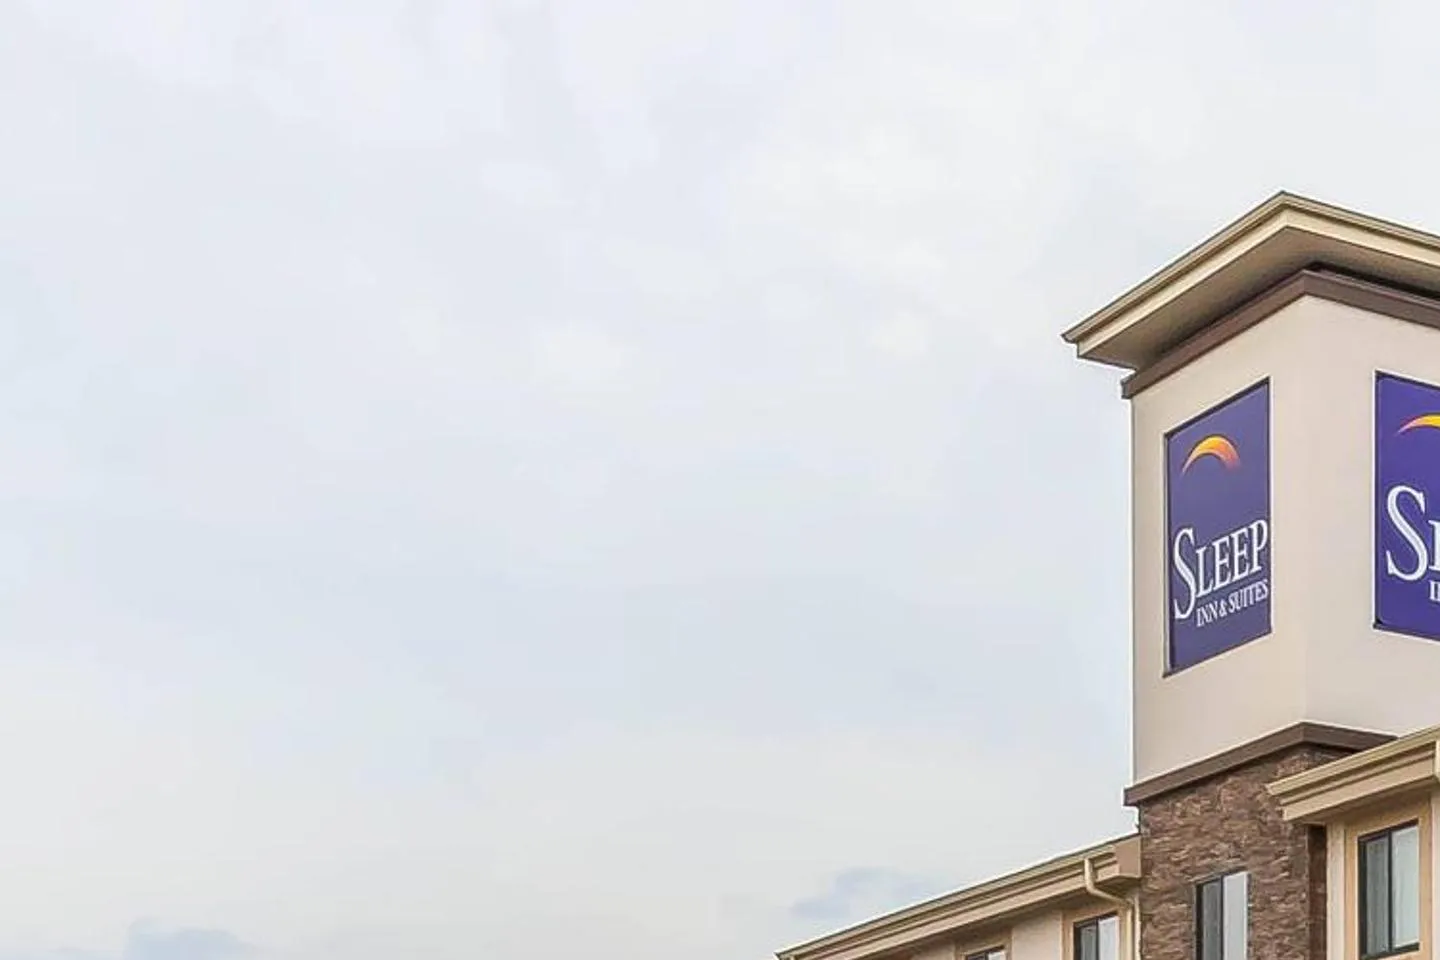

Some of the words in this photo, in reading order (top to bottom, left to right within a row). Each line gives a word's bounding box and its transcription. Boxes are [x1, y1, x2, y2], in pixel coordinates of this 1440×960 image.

[1174, 519, 1268, 619] SLEEP
[1196, 601, 1218, 627] INN
[1219, 599, 1228, 617] &
[1228, 579, 1268, 613] SUITES
